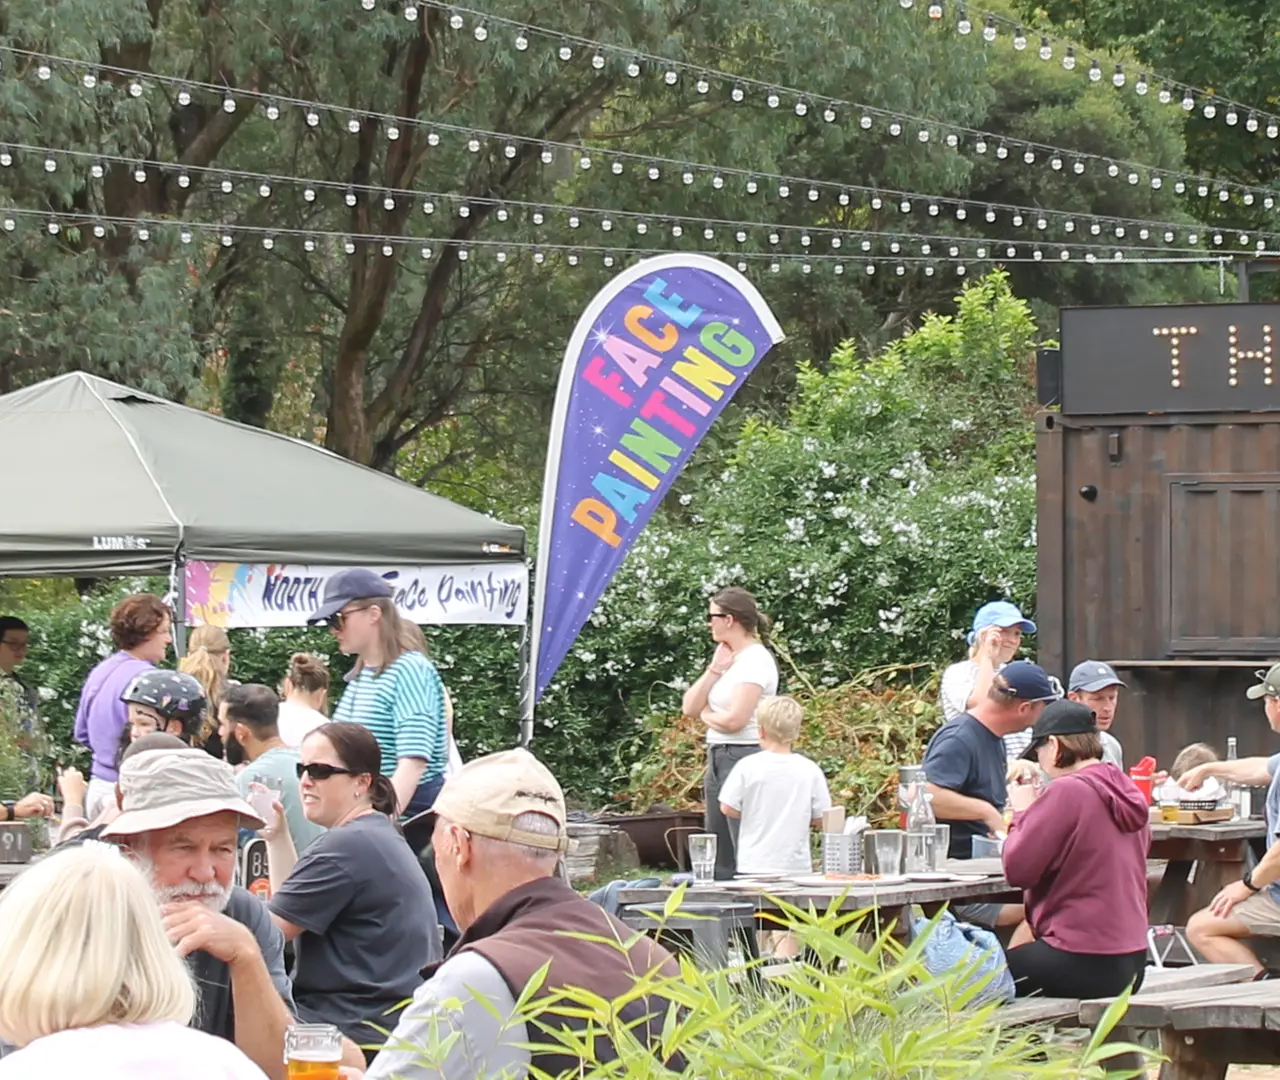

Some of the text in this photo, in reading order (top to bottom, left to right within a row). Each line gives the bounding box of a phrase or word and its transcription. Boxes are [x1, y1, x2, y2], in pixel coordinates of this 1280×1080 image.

[581, 277, 705, 409] FACE
[570, 321, 757, 549] PAINTING
[262, 575, 323, 612] NORTH
[437, 571, 522, 618] Painting
[2, 831, 22, 851] 91
